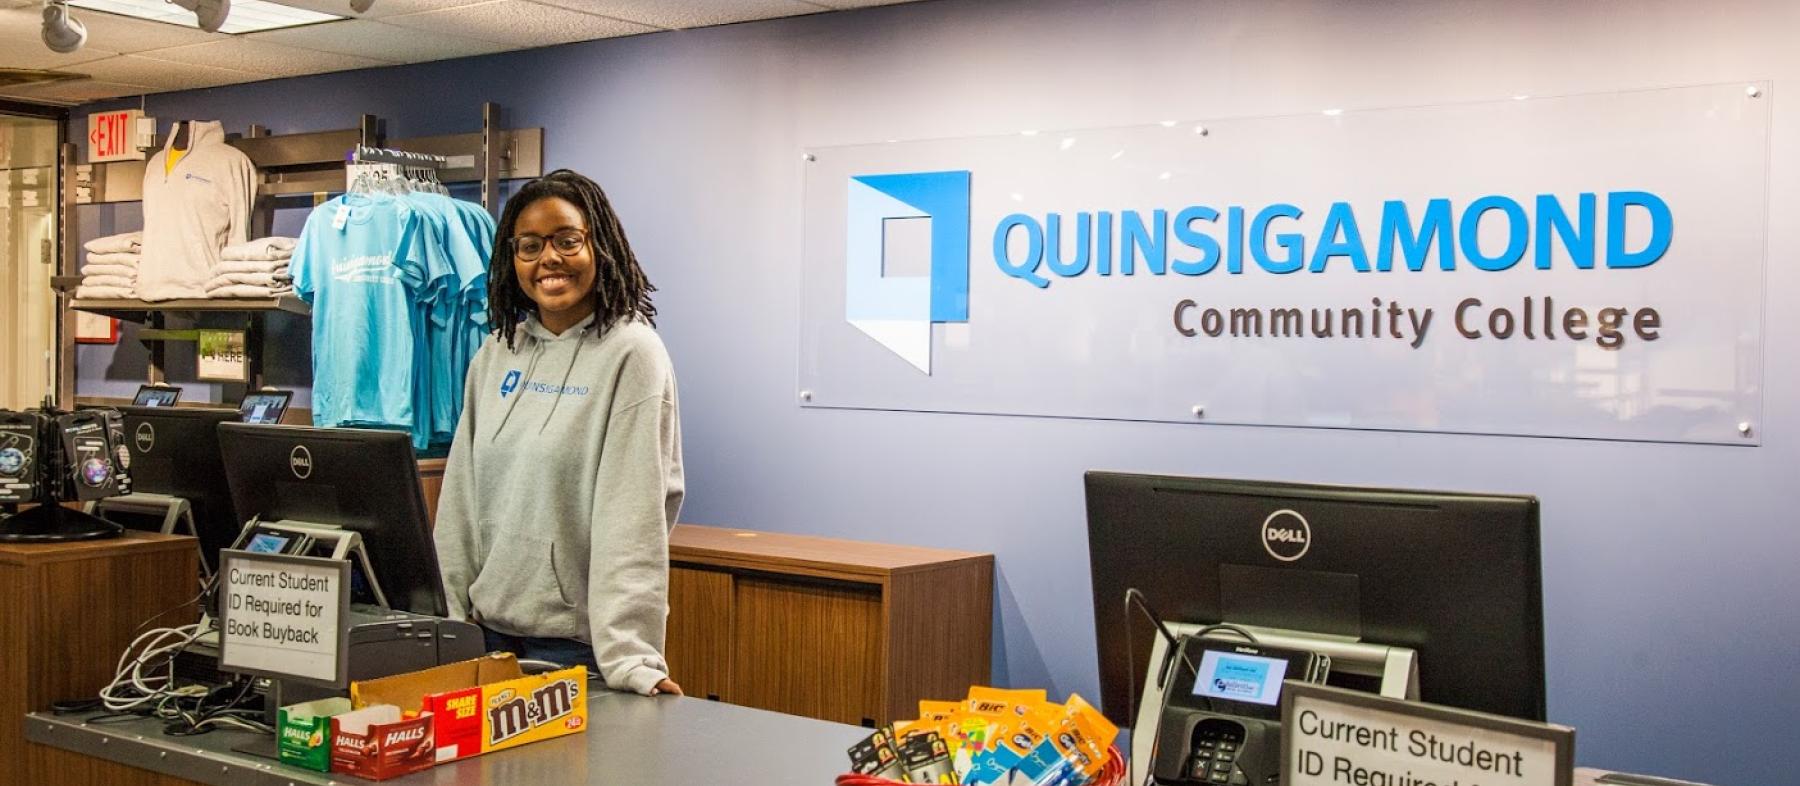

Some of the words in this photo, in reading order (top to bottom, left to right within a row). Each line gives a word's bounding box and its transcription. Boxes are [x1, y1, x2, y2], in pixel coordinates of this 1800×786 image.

[97, 113, 128, 157] EXIT
[993, 191, 1674, 289] QUINSIGAMOND
[1173, 297, 1434, 349] Community
[1454, 296, 1662, 350] College
[1267, 527, 1306, 543] DELL
[230, 568, 275, 588] Current
[278, 571, 329, 592] Student
[228, 593, 242, 610] ID
[245, 594, 301, 617] Required
[305, 600, 323, 618] for
[227, 618, 259, 638] Book
[263, 621, 319, 645] Buyback
[446, 694, 478, 712] SHARE
[456, 706, 476, 720] SIZE
[283, 726, 311, 741] HALLS
[336, 735, 366, 749] HALLS
[384, 726, 425, 747] HALLS
[1299, 710, 1399, 752] Current
[1408, 729, 1523, 777] Student
[1298, 749, 1324, 776] ID
[1333, 756, 1458, 786] Requi
